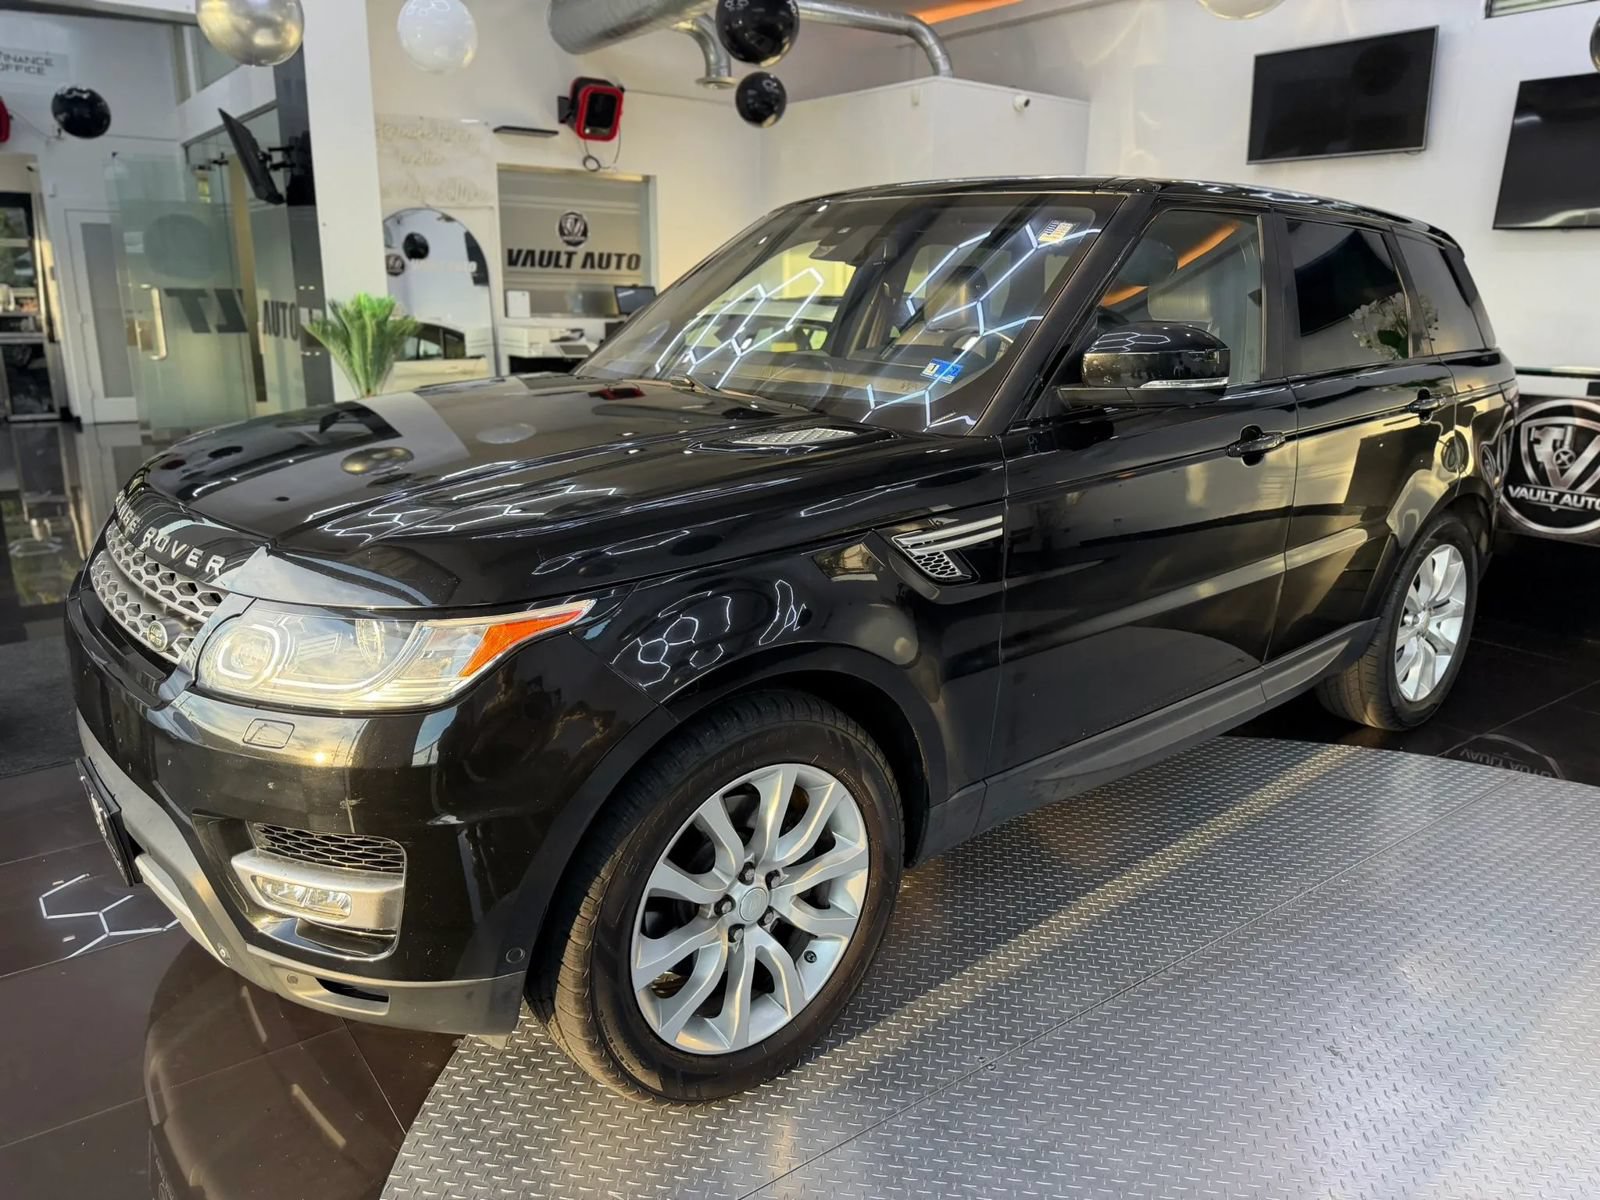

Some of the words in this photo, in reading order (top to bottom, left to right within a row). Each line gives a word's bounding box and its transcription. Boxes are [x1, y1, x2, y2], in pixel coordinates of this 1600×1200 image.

[0, 51, 54, 67] INANCE
[507, 248, 577, 269] VAULT
[581, 252, 641, 271] AUTO
[263, 300, 299, 341] AUTO
[1508, 484, 1560, 504] VAULT
[143, 527, 226, 577] ROVER
